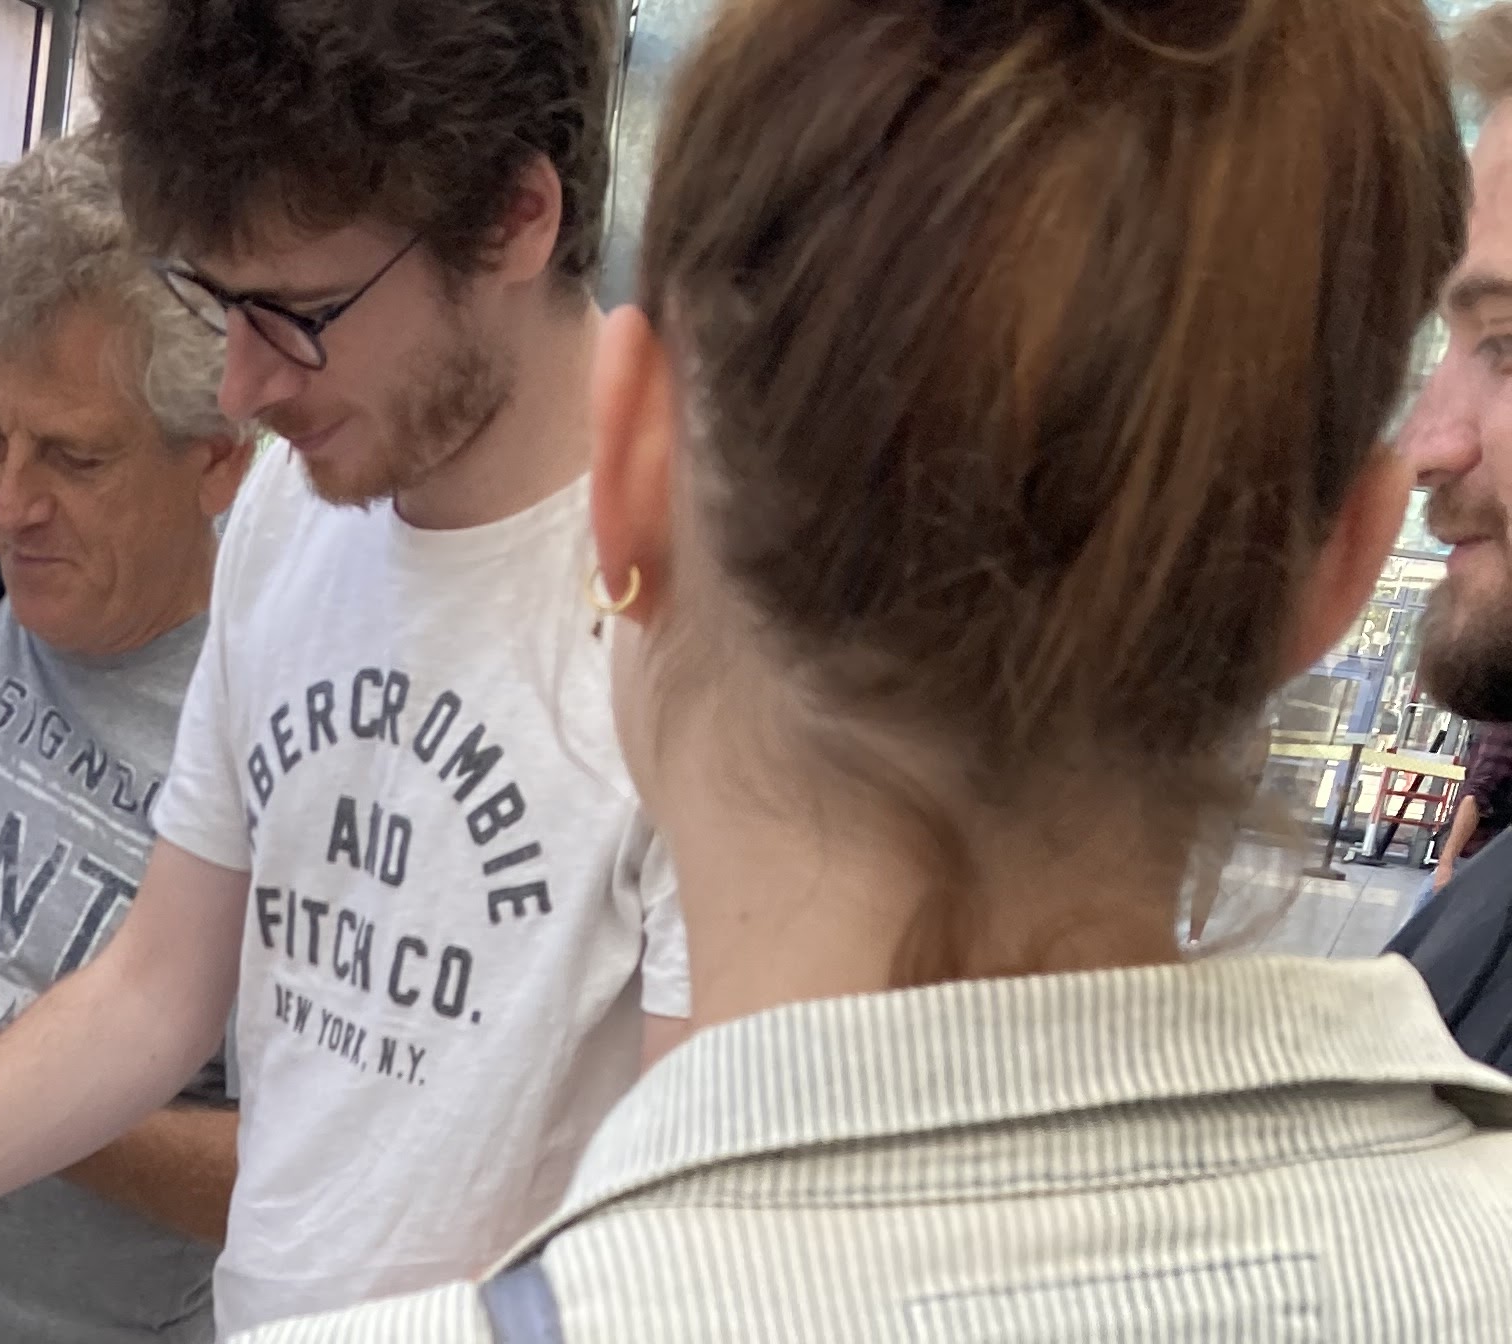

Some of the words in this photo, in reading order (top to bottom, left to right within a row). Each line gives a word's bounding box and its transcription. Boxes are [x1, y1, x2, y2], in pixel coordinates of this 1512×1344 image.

[256, 887, 374, 992] FITCH
[388, 935, 481, 1024] CO.
[378, 1036, 425, 1086] N.Y.
